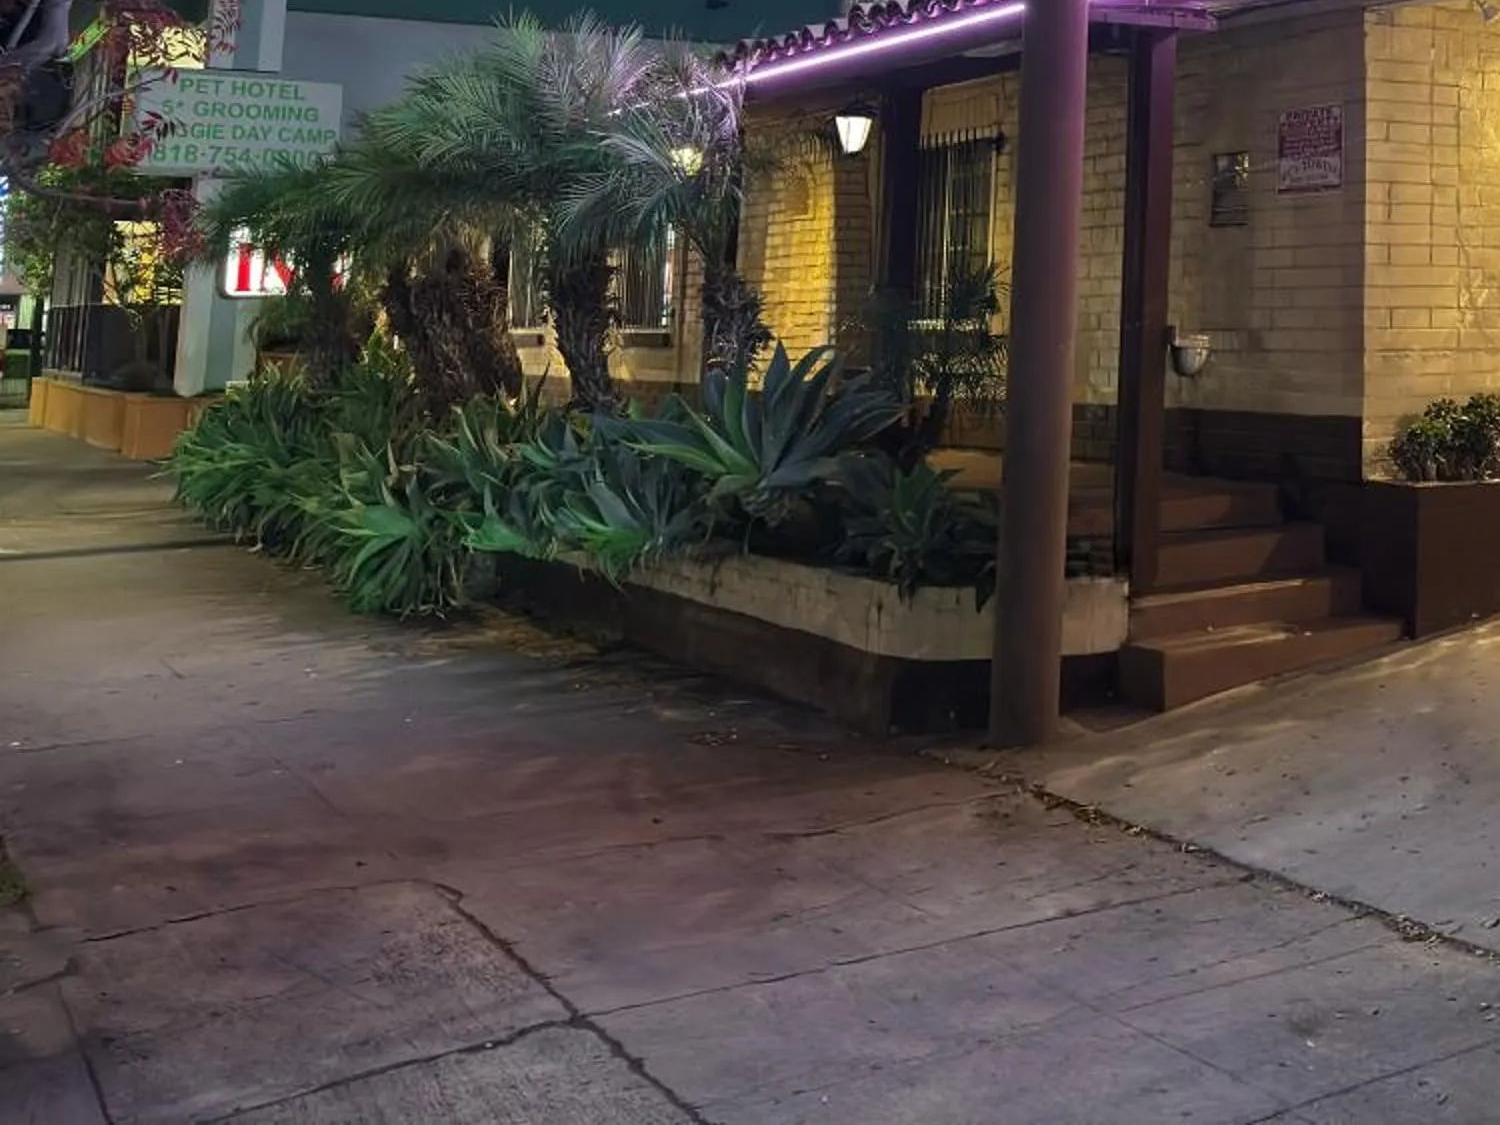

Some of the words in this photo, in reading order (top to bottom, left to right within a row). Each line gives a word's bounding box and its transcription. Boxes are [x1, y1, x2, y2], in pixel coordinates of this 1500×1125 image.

[179, 78, 225, 95] PET
[232, 81, 305, 101] HOTEL
[193, 101, 320, 123] GROOMING
[231, 125, 274, 142] DAY
[278, 127, 337, 146] CAMP
